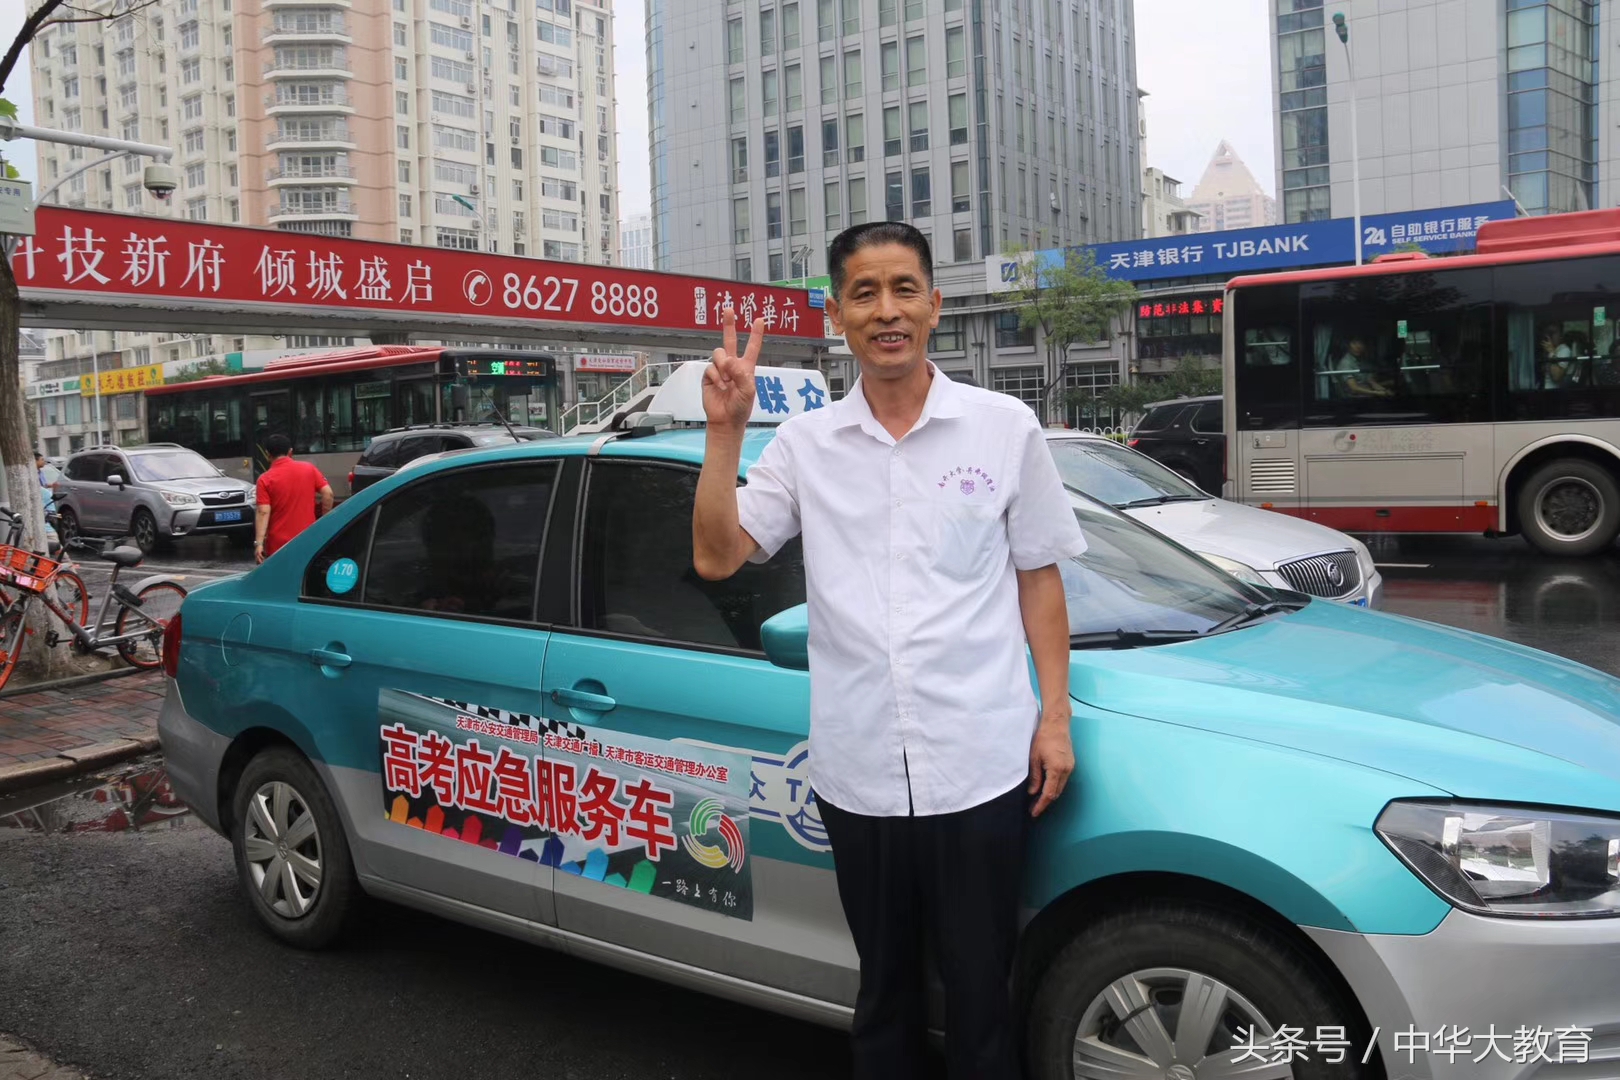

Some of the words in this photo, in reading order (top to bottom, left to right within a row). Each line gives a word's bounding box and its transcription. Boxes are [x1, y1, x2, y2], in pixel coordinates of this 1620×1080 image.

[1110, 245, 1204, 270] 天津银行
[1212, 234, 1310, 260] TJBANK
[1364, 226, 1387, 246] 24
[1413, 233, 1448, 243] SERVICE
[253, 244, 433, 304] 倾城盛启
[503, 272, 579, 312] 8627
[591, 281, 659, 319] 8888
[755, 376, 824, 415] 联众
[333, 562, 354, 576] 1.70
[456, 716, 539, 743] 天津市公安交通管理局
[544, 734, 600, 757] 天津交通广播
[605, 745, 728, 781] 天津市客运交通管理办公室
[381, 725, 675, 859] 高考应急服务车
[662, 878, 737, 908] 一路上有你
